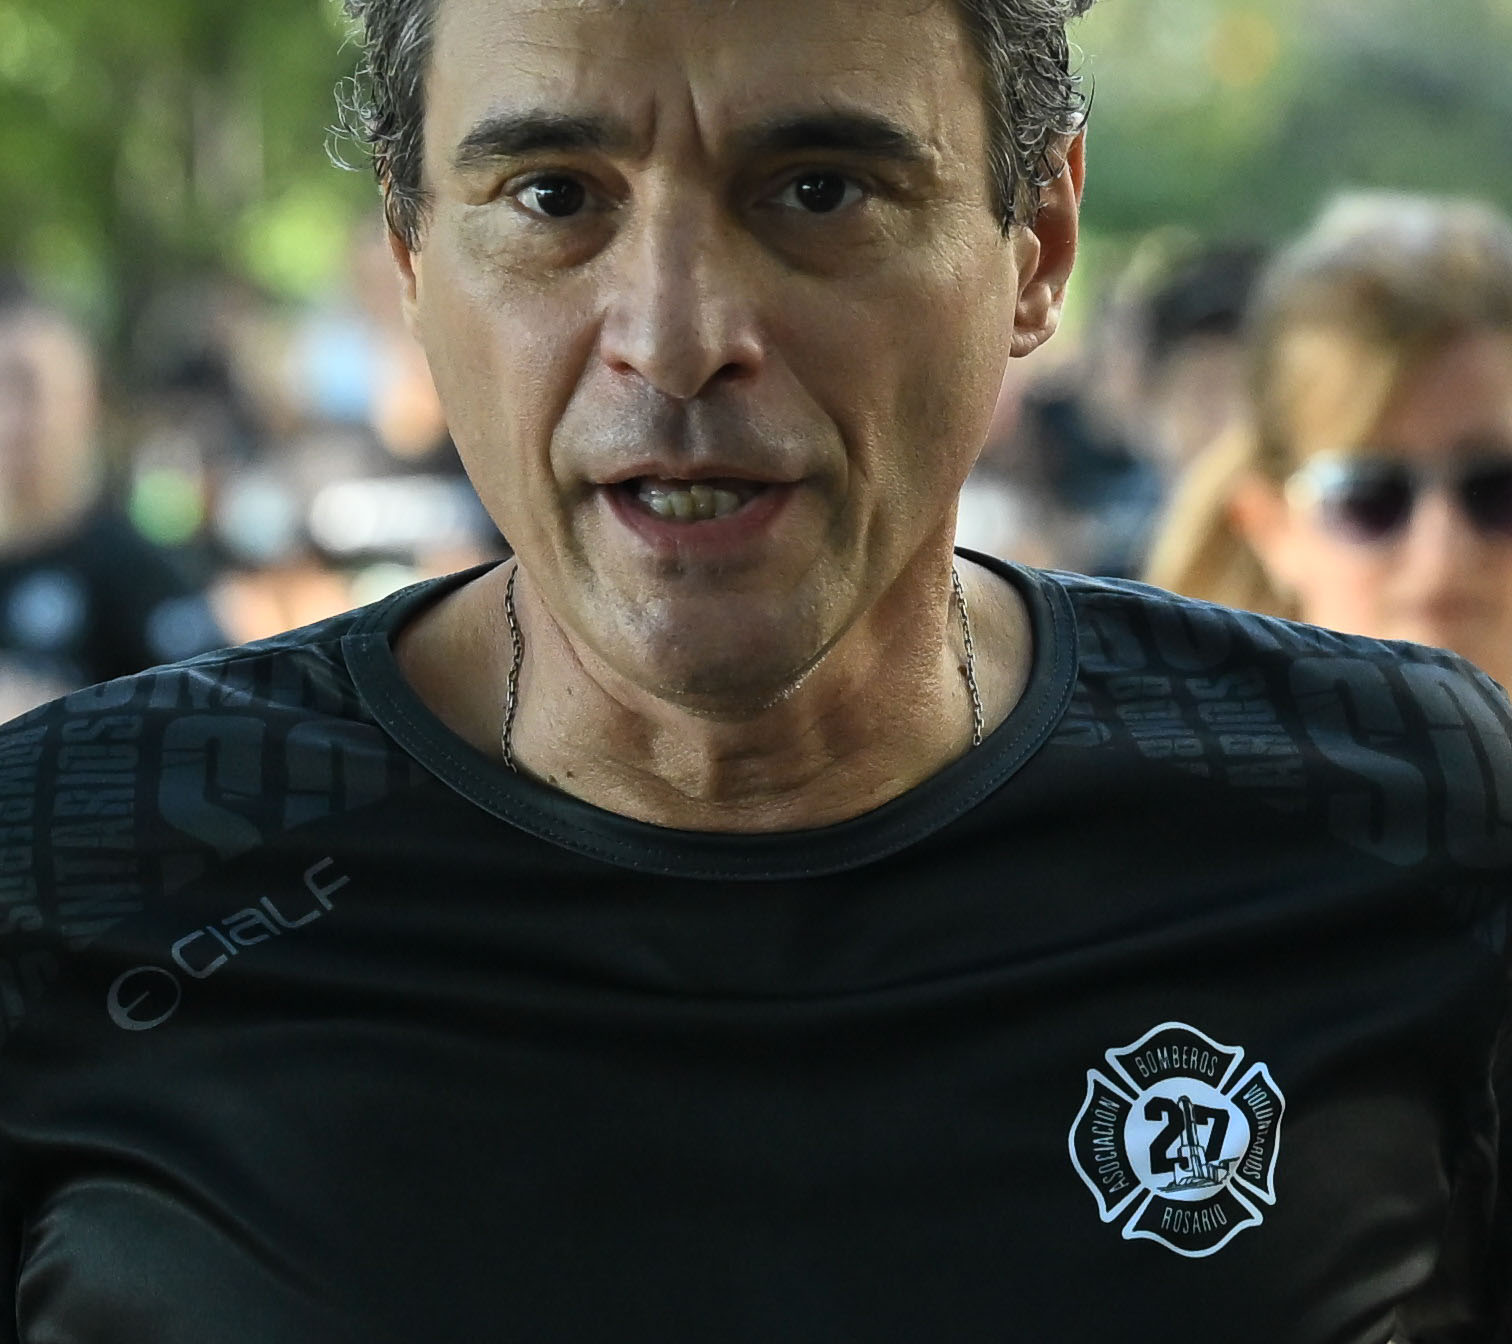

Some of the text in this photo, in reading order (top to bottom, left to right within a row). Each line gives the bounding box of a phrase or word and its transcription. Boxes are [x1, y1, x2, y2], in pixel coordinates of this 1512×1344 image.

[1134, 1045, 1219, 1079] BOMBEROS
[1143, 1094, 1231, 1176] 27
[1161, 1202, 1229, 1236] ROSARIO
